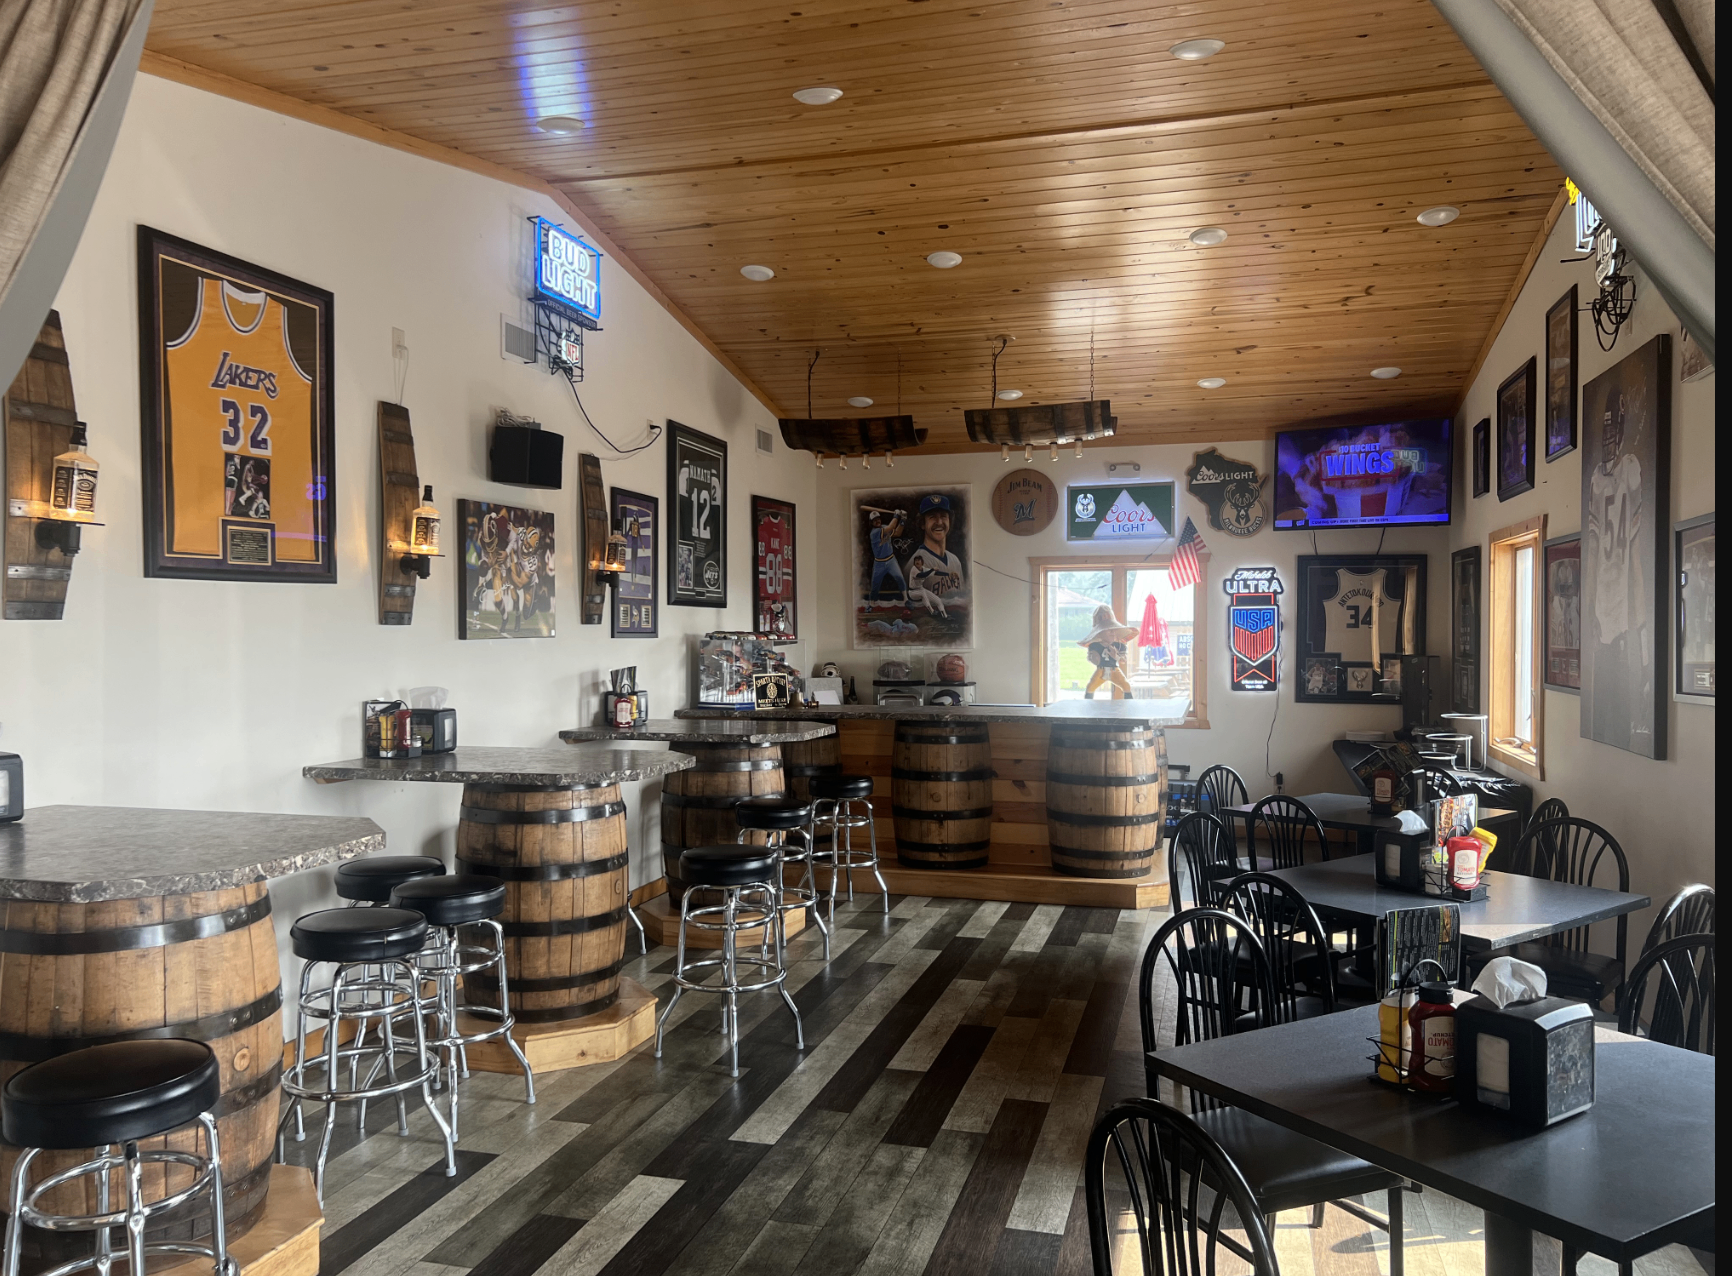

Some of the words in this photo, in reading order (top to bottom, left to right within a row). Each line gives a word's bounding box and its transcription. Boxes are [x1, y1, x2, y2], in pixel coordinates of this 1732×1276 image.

[549, 229, 590, 277] BUD
[541, 254, 598, 310] LIGHT
[547, 299, 566, 316] OFFICIAL
[566, 309, 578, 320] BEER
[577, 313, 597, 329] SPONSOR
[566, 342, 579, 363] NFL
[209, 350, 279, 400] LAKERS
[220, 397, 272, 456] 32
[1350, 442, 1381, 453] BUCKET
[689, 464, 711, 484] NAMATH
[1326, 451, 1395, 477] WINGS
[1007, 481, 1021, 494] JIM
[1022, 478, 1042, 492] BEAM
[1197, 470, 1224, 482] Coors
[1225, 471, 1254, 480] LIGHT
[691, 487, 711, 540] 12
[1102, 503, 1155, 524] Coors
[1112, 523, 1146, 533] LIGHT
[1248, 517, 1263, 533] BUCKS
[1604, 492, 1627, 566] 54
[766, 552, 783, 594] 88
[1235, 570, 1273, 580] Michelob
[1226, 580, 1281, 593] ULTRA
[1338, 588, 1385, 608] ANTETOKOUNO
[1234, 610, 1273, 632] USA
[1346, 605, 1374, 628] 34
[756, 676, 771, 687] SPARTA
